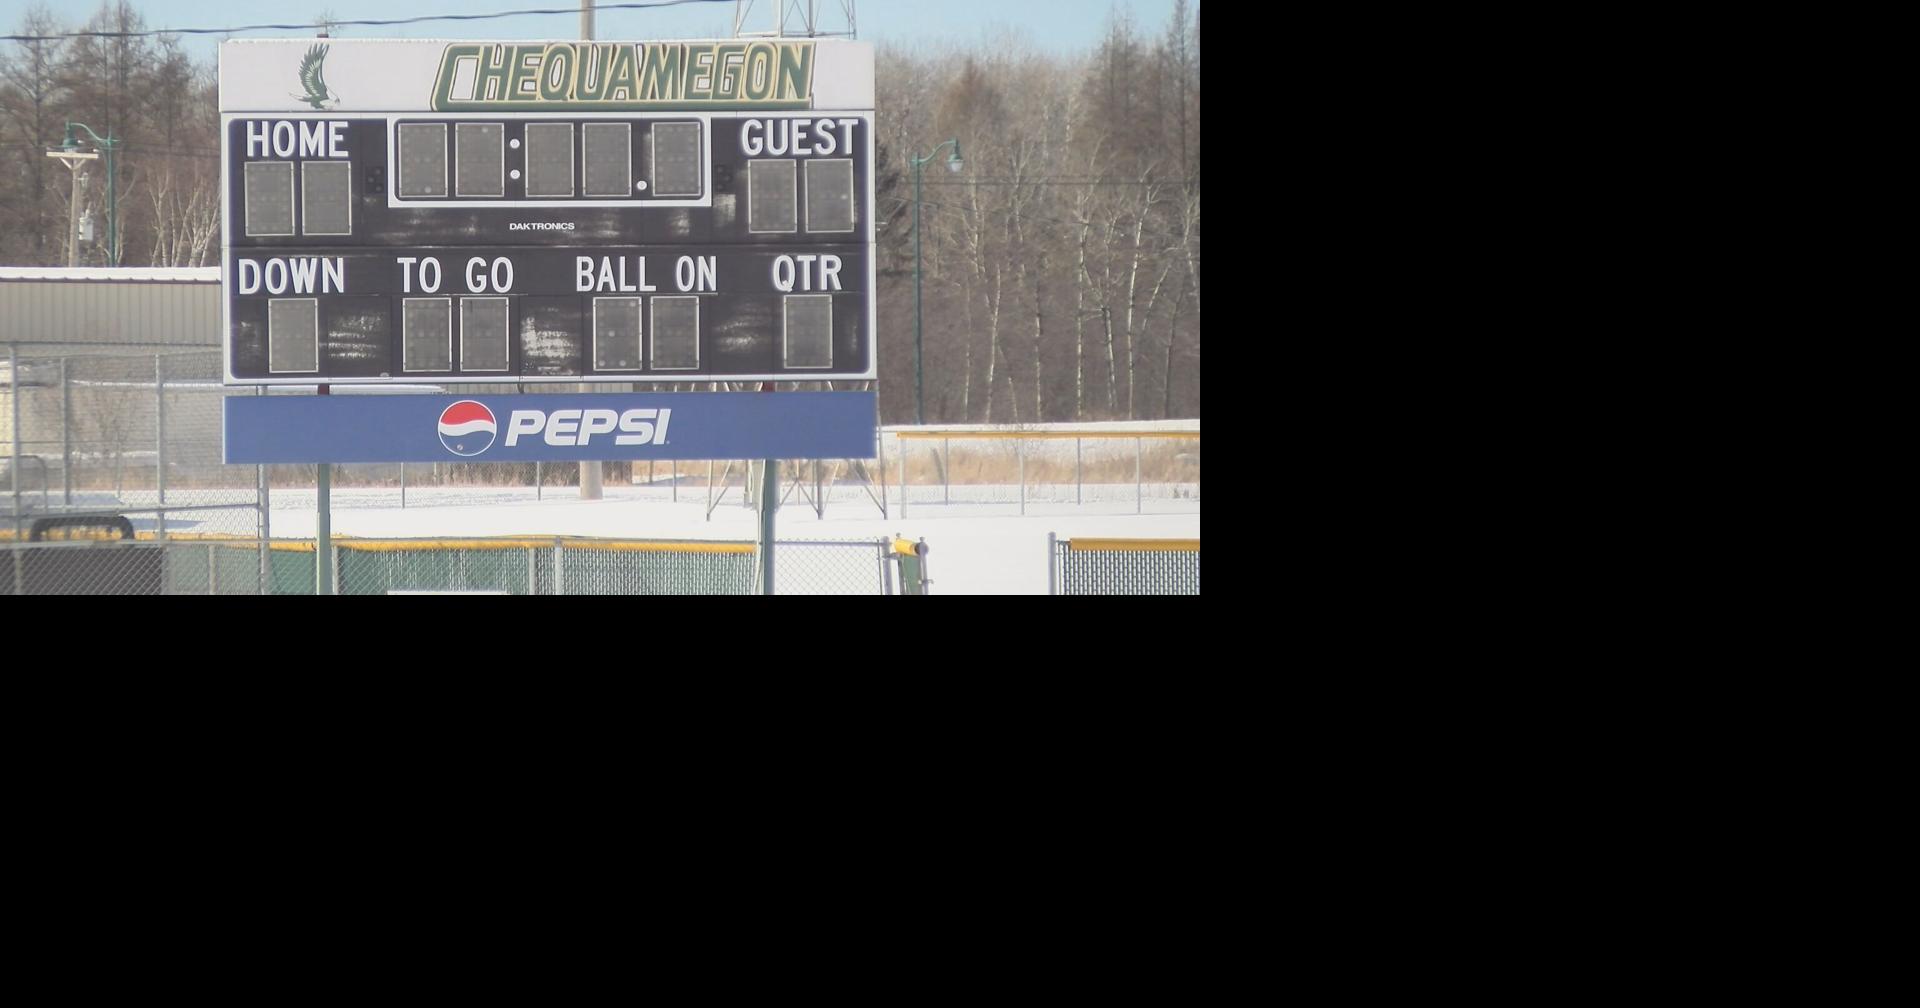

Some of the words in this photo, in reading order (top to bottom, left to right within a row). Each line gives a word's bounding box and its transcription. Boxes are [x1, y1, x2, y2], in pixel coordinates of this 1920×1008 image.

[431, 41, 817, 111] CHEQUAMEGON
[246, 120, 349, 158] HOME
[740, 118, 859, 156] GUEST
[509, 222, 576, 231] DAKTRONICS
[238, 257, 345, 295] DOWN
[396, 256, 442, 294] TO
[465, 256, 514, 294] GO
[576, 255, 657, 292] BALL
[675, 255, 717, 292] ON
[772, 254, 842, 293] QTR
[504, 408, 671, 447] PEPSI
